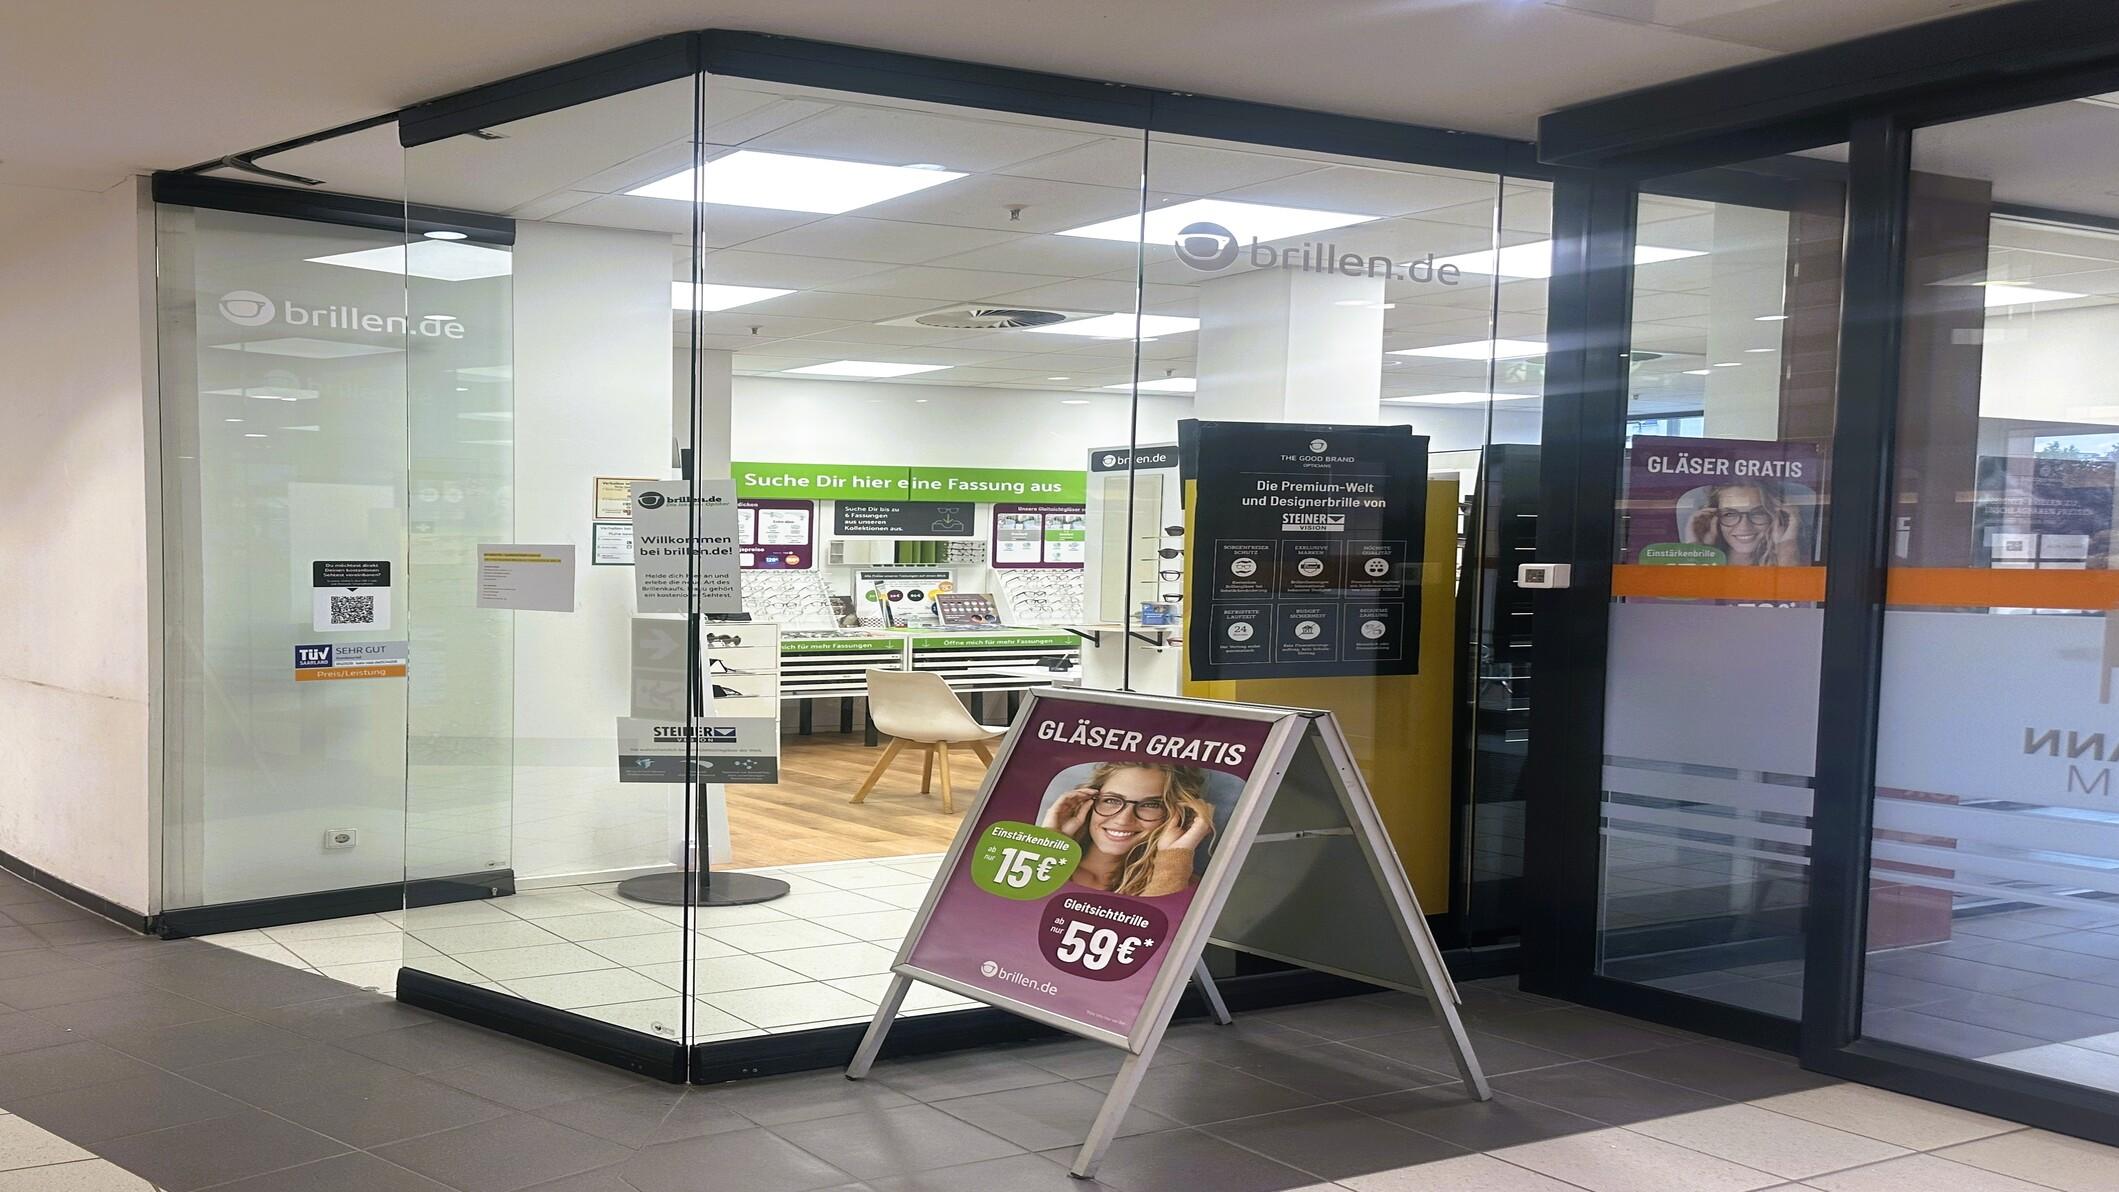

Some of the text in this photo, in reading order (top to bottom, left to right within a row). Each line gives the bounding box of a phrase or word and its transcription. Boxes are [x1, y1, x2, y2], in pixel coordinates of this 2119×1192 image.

[1250, 236, 1460, 285] brillen.de
[285, 301, 465, 338] brillen.de
[1647, 453, 1802, 477] GLÄSER GRATIS
[745, 473, 1062, 494] Suche Dir hier eine Fassung aus
[1257, 480, 1374, 493] Die Premium-Welt
[1242, 496, 1386, 509] und Designerbrille von
[1282, 513, 1326, 524] STEINER
[641, 536, 731, 544] Willkommen
[640, 547, 660, 556] bei
[664, 547, 733, 556] brillen.de!
[1647, 549, 1715, 558] Einstärkenbrille
[1234, 625, 1247, 633] 24
[335, 647, 363, 655] SEHR
[365, 646, 386, 654] GUT
[317, 669, 386, 678] Preis/Leistung
[1038, 719, 1246, 766] GLÄSER GRATIS
[992, 827, 1070, 851] Einstärkenbrille
[1064, 898, 1149, 928] Gleitsichtbrille
[1054, 917, 1065, 925] ab
[1050, 925, 1064, 935] nur
[998, 967, 1058, 996] brillen.de
